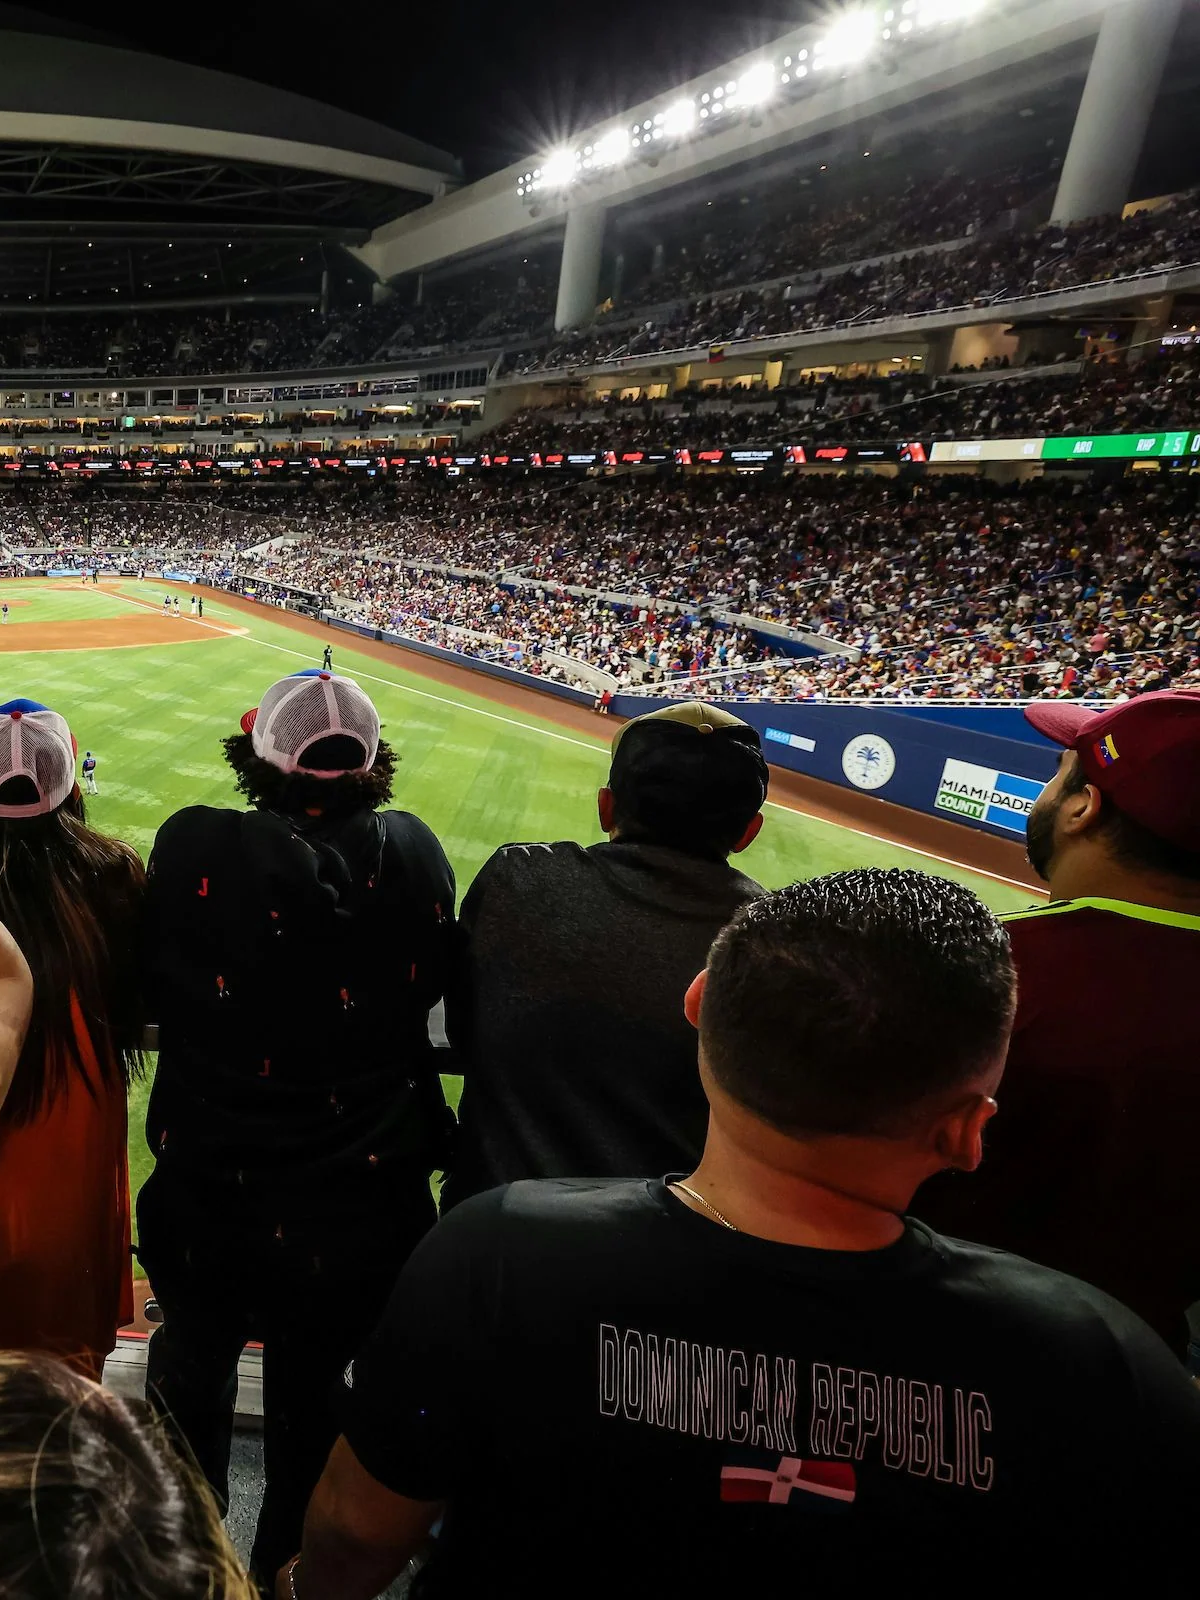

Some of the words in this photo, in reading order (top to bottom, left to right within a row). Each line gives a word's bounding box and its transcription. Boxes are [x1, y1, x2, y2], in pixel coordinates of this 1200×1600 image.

[938, 793, 985, 817] COUNTY
[941, 778, 1034, 814] MIAMI-DADE
[598, 1323, 798, 1453] DOMINICAN
[810, 1362, 995, 1492] REPUBLIC
